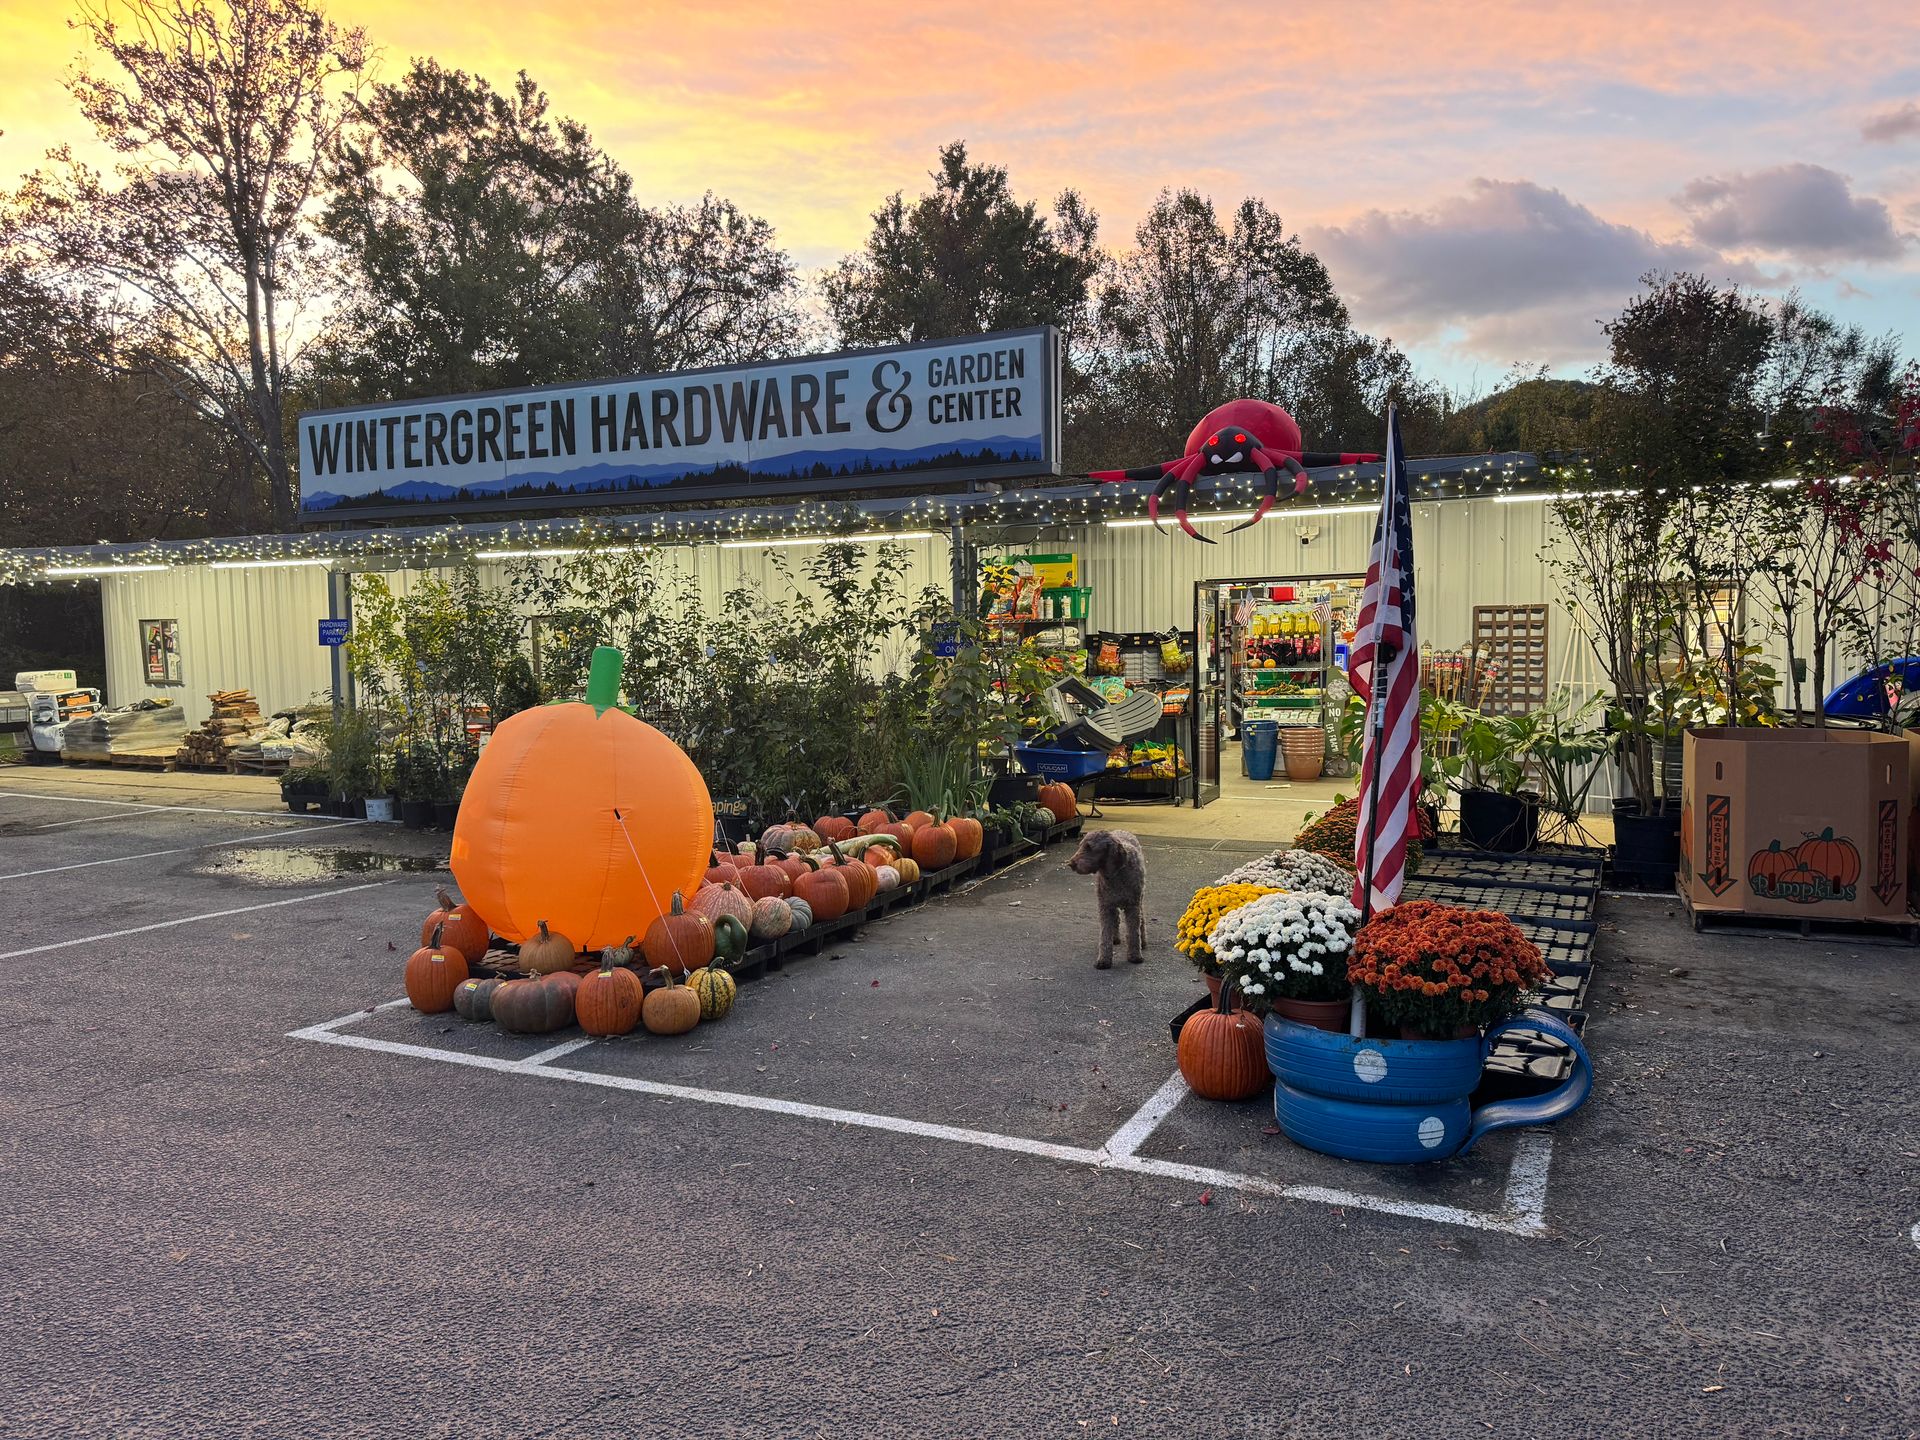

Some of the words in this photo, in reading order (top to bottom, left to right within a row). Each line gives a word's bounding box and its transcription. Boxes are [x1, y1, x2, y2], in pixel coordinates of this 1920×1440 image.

[927, 347, 1025, 389] GARDEN
[308, 398, 576, 476] WINTERGREEN
[590, 369, 851, 454] HARDWARE
[865, 359, 912, 434] &
[927, 386, 1023, 425] CENTER
[1328, 708, 1341, 717] NO
[712, 799, 741, 816] aping
[1713, 816, 1722, 842] WATCH
[1884, 823, 1892, 849] WATCH
